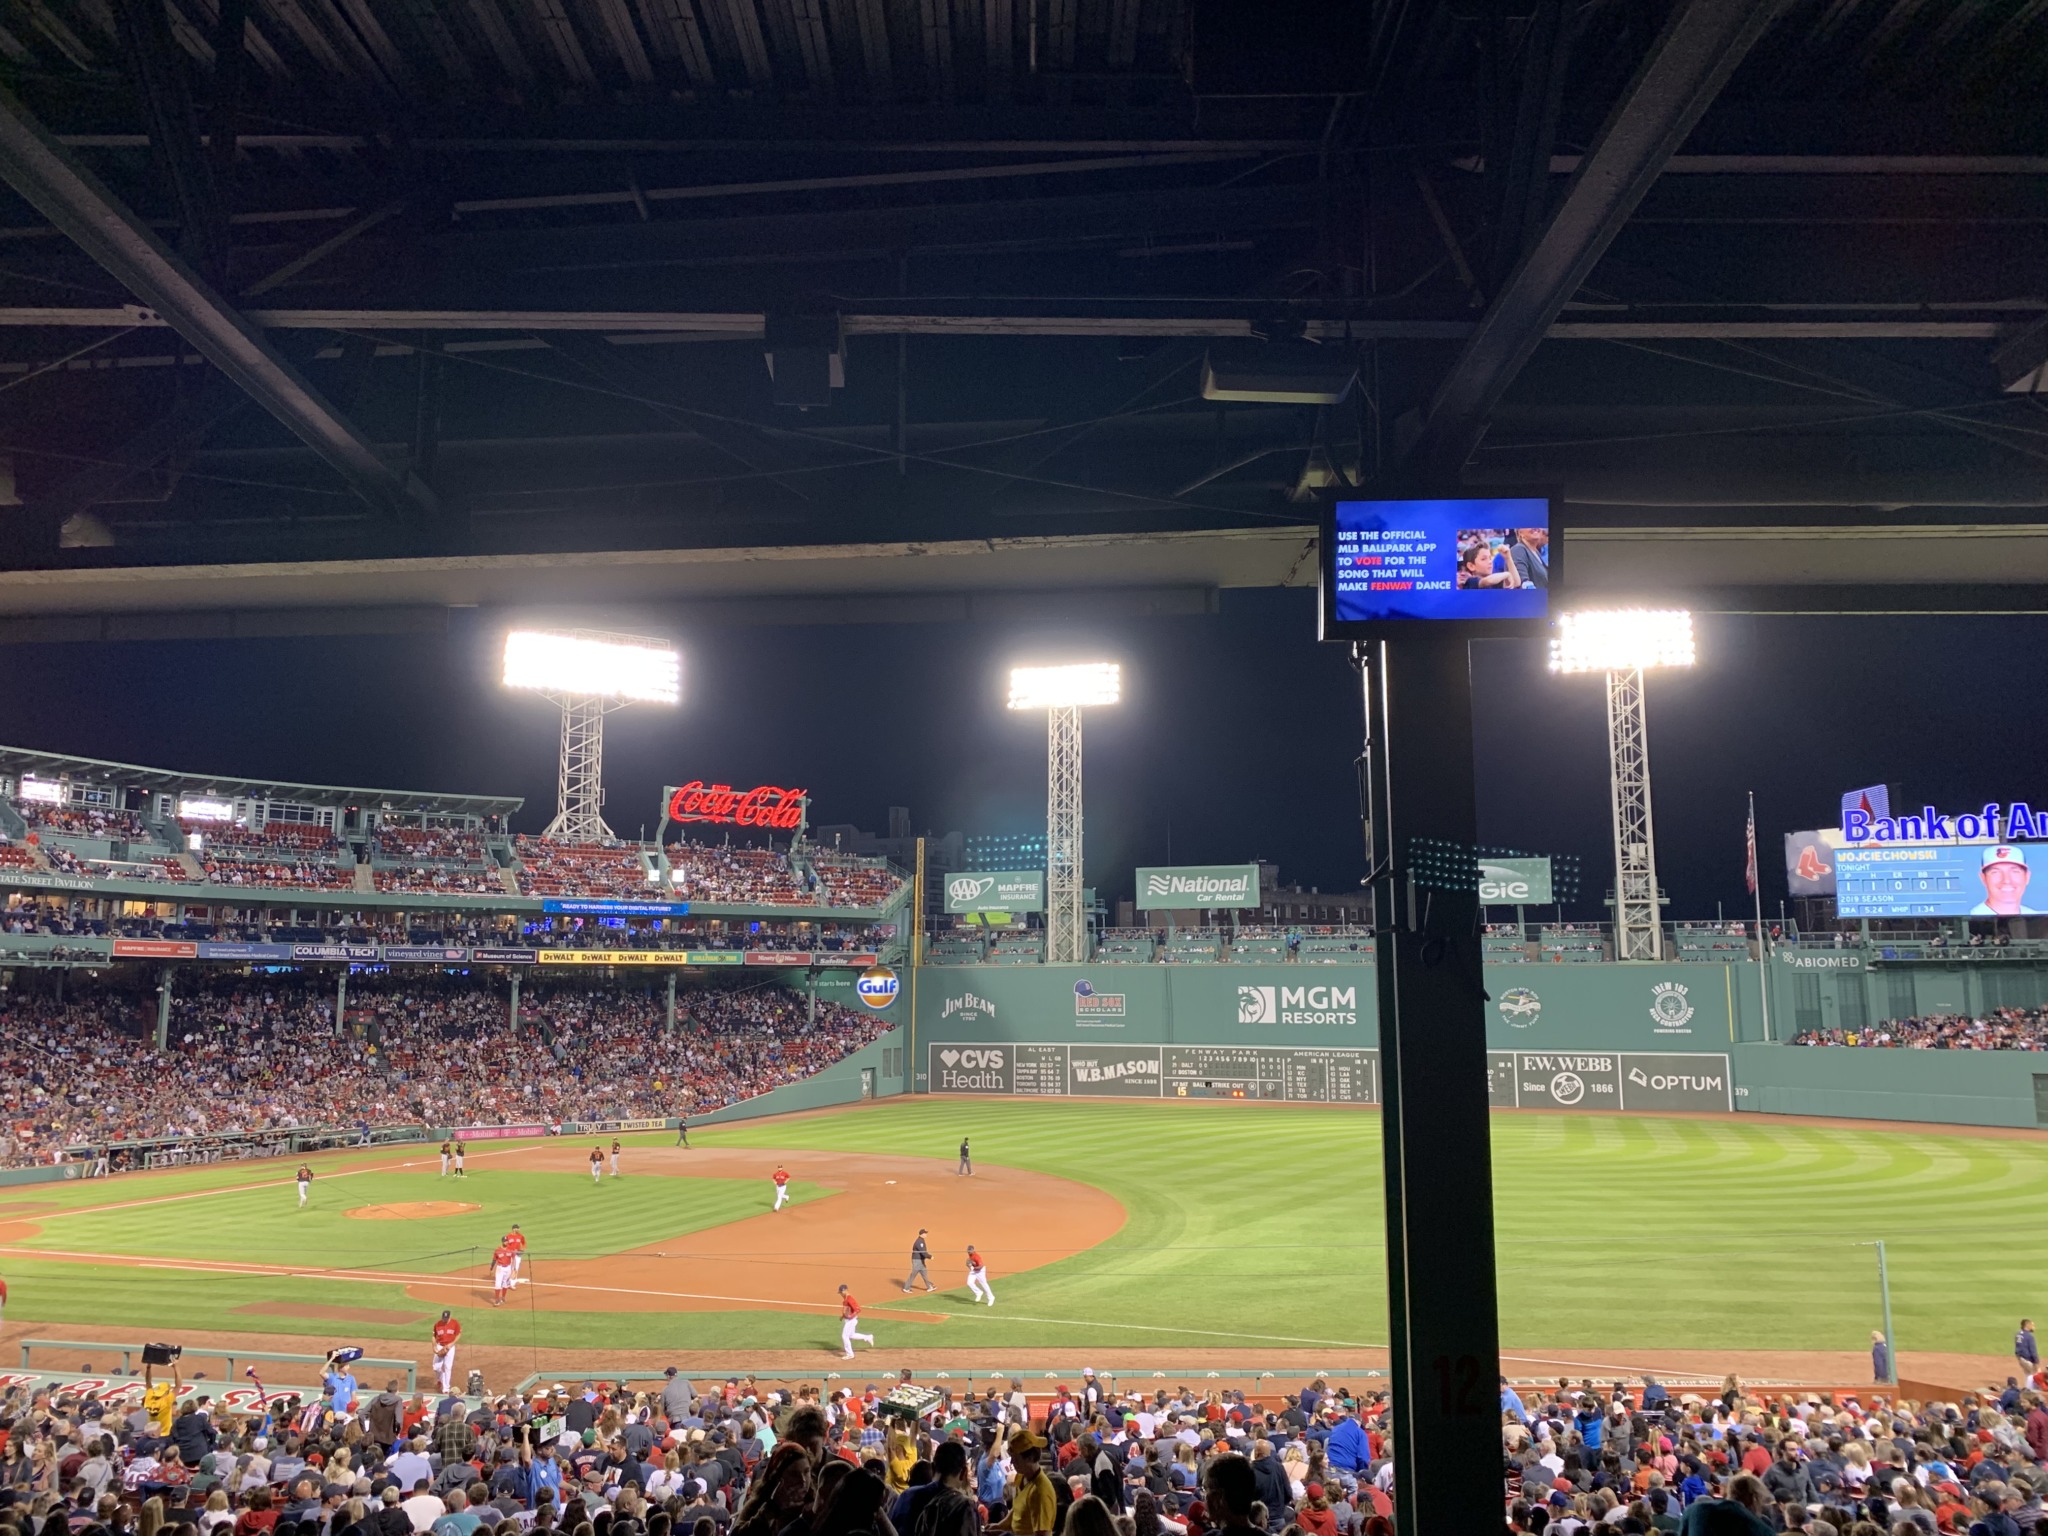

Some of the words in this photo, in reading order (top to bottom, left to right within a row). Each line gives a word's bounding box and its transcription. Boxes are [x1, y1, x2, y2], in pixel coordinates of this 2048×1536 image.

[1338, 531, 1358, 541] USE
[1360, 531, 1380, 541] THE
[1382, 530, 1426, 540] OFFICIAL
[1338, 544, 1359, 554] MLB
[1362, 544, 1413, 554] BALLPARK
[1416, 543, 1437, 553] APP
[1338, 556, 1352, 566] TO
[1355, 556, 1382, 566] VOTE
[1384, 556, 1406, 566] FOR
[1408, 555, 1427, 566] THE
[1338, 569, 1369, 580] SONG
[1372, 569, 1398, 579] THAT
[1400, 568, 1424, 578] WILL
[1338, 582, 1368, 592] MAKE
[1370, 582, 1413, 592] FENWAY
[1416, 581, 1451, 590] DANCE
[1841, 806, 1951, 842] Bank
[1956, 802, 2000, 839] of
[2006, 802, 2048, 838] A
[1837, 850, 1938, 862] WOJCIECHOWSKI
[1837, 864, 1870, 872] TONIGHT
[22, 875, 53, 886] STREET
[54, 878, 94, 889] PAVILION
[998, 884, 1038, 892] MAPFRE
[1170, 875, 1248, 892] National
[1894, 880, 1902, 890] 0
[1920, 880, 1928, 890] 0
[951, 879, 980, 900] AAA
[1215, 894, 1244, 902] Rental
[295, 946, 347, 956] COLUMBIA
[349, 948, 374, 956] TECH
[388, 950, 422, 959] vineyard
[1795, 957, 1860, 968] ABIOMED
[858, 980, 896, 994] Gulf
[1674, 983, 1688, 996] 103
[1080, 997, 1100, 1008] RED
[1102, 997, 1122, 1008] SOX
[1282, 986, 1356, 1010] MGM
[942, 997, 962, 1018] JIM
[964, 993, 996, 1018] BEAM
[1282, 1012, 1356, 1024] RESORTS
[960, 1050, 1004, 1069] CVS
[1524, 1056, 1556, 1070] F.W.
[1558, 1056, 1612, 1072] WEBB
[942, 1070, 1004, 1088] Health
[1651, 1075, 1722, 1091] OPTUM
[1178, 1086, 1187, 1096] 15
[1524, 1082, 1546, 1092] Since
[1560, 1081, 1577, 1094] WEBB
[1591, 1084, 1614, 1093] 1866
[1734, 1087, 1748, 1096] 379
[1432, 1355, 1482, 1414] 12
